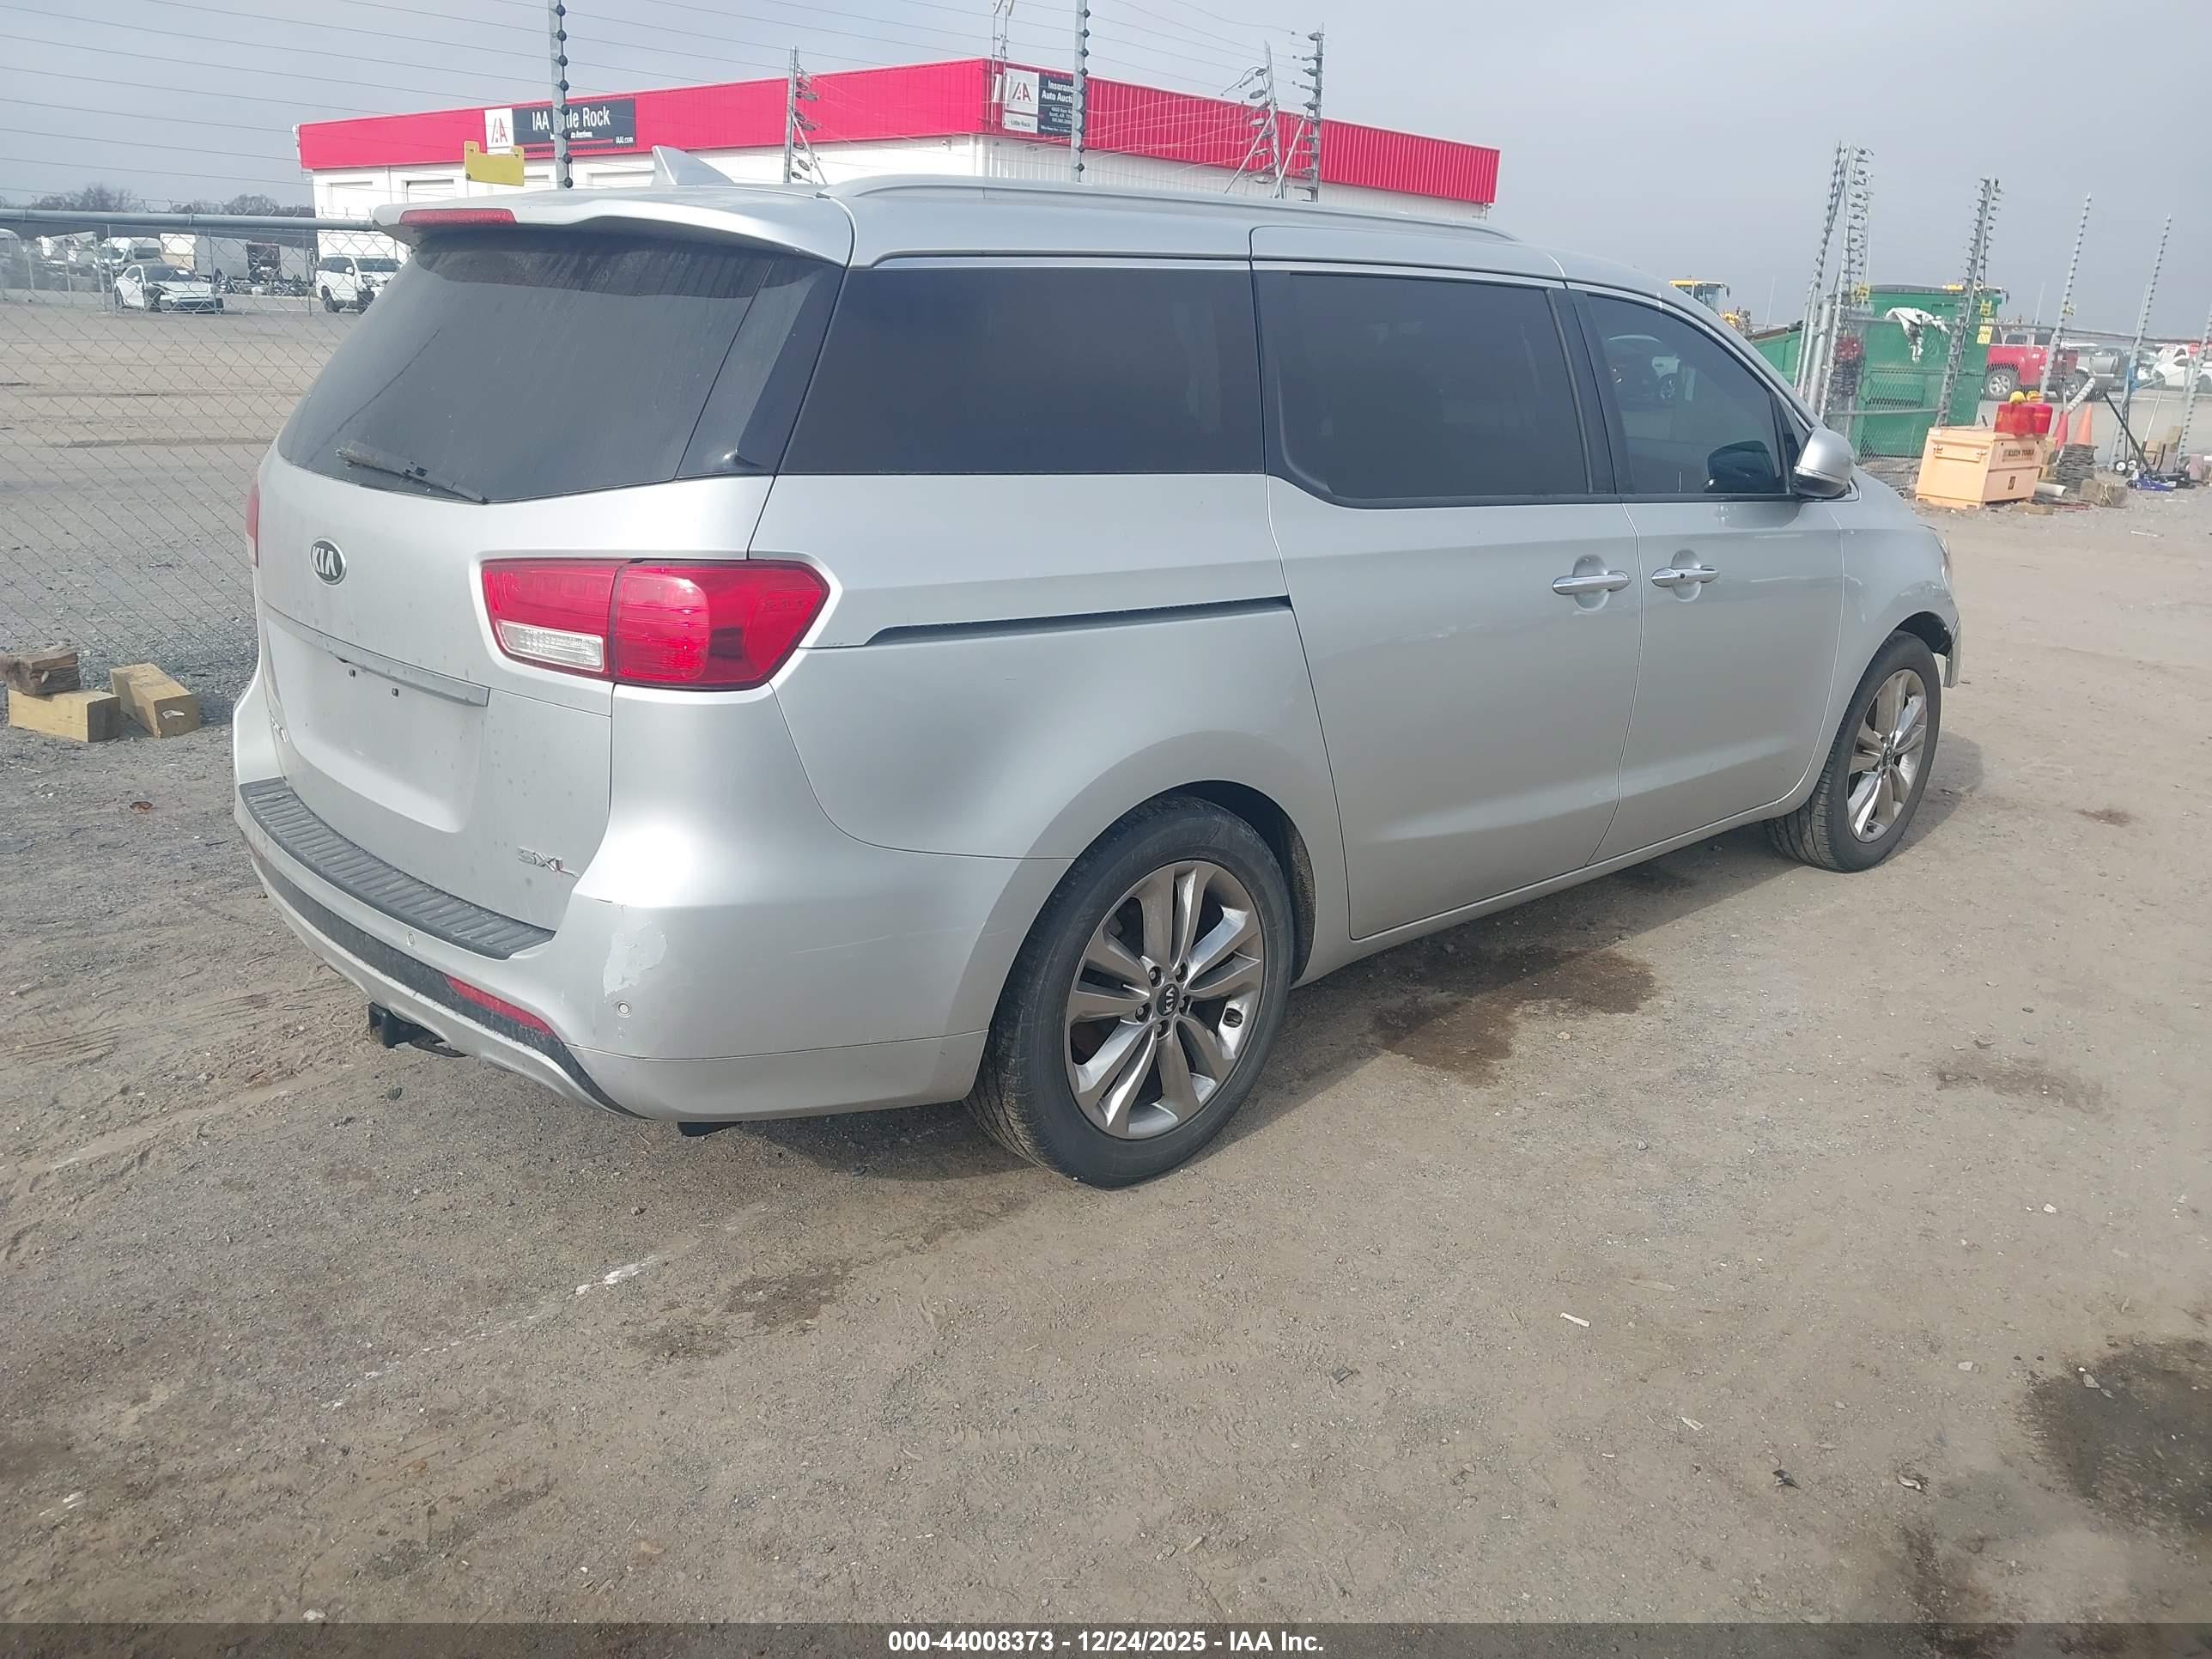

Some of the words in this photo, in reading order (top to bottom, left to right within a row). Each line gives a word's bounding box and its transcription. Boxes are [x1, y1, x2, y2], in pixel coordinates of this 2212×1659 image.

[1042, 89, 1056, 100] Auto
[1048, 79, 1074, 92] Insuranc
[532, 111, 550, 131] IAA
[582, 105, 611, 127] Rock
[311, 545, 338, 576] KIA
[1163, 988, 1175, 1014] KIA
